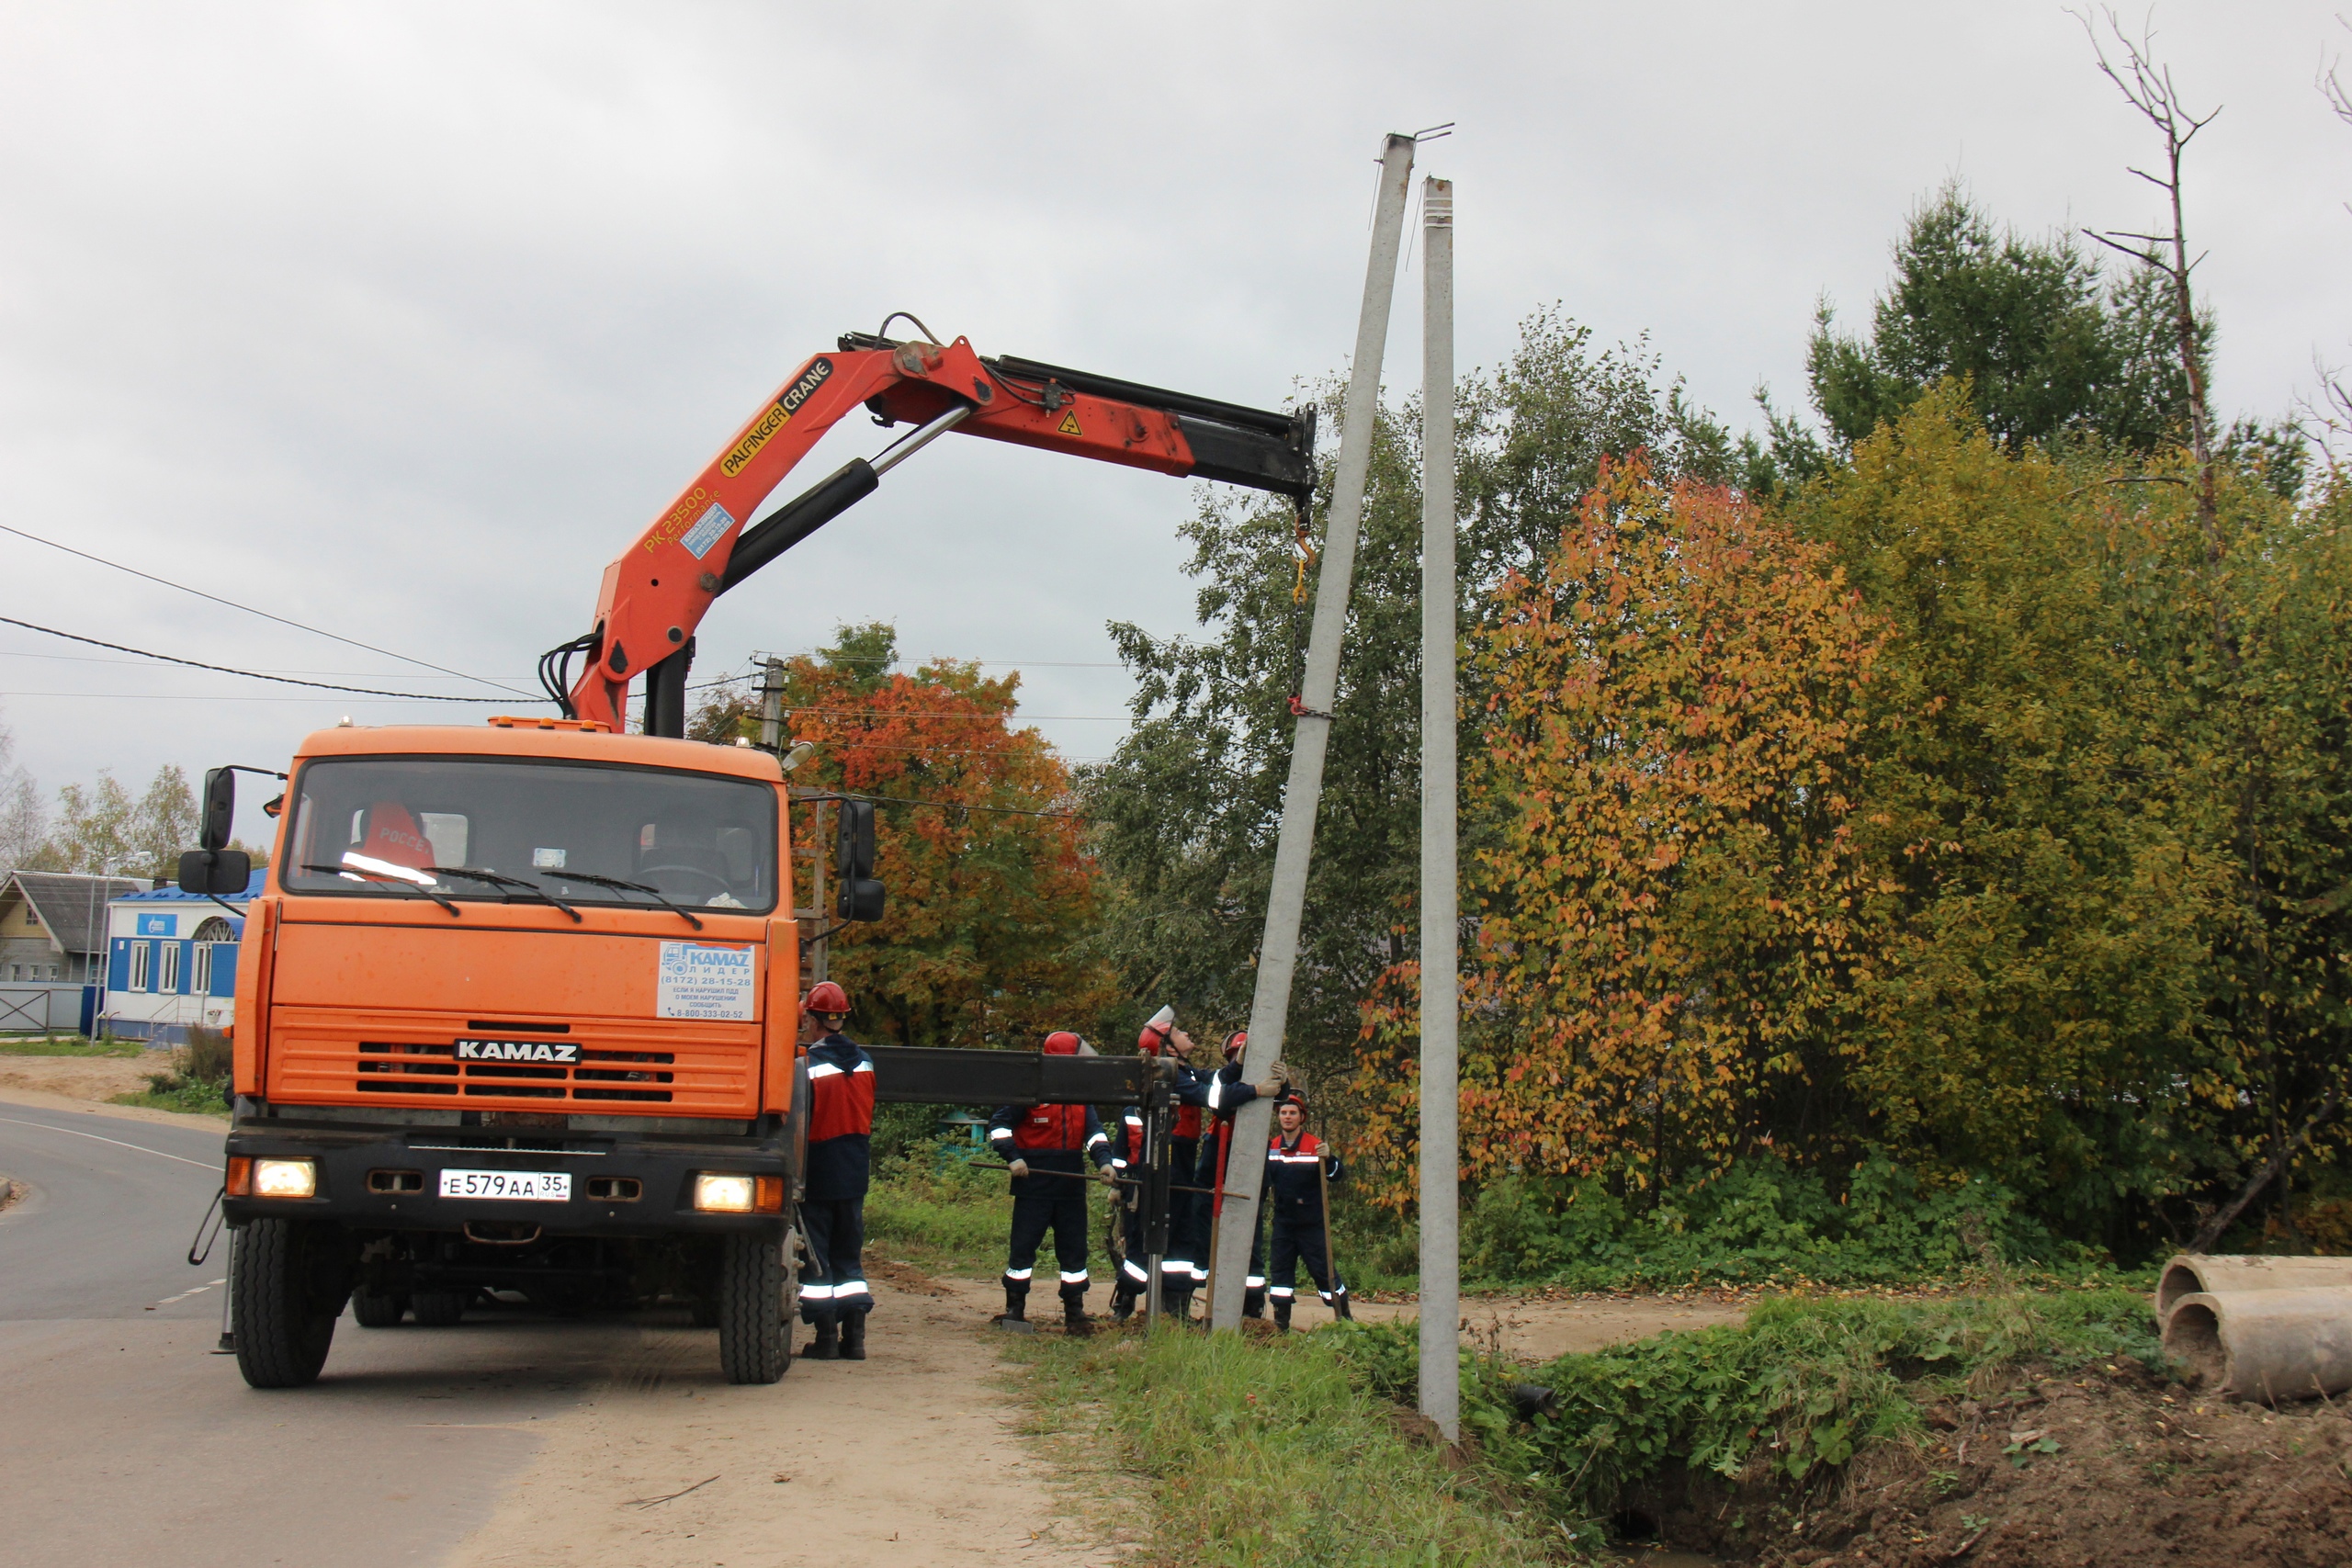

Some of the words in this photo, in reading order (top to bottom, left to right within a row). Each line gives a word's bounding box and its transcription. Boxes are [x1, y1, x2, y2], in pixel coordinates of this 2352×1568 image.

[723, 407, 786, 474] PALFINGER
[783, 362, 830, 411] CRANE
[644, 533, 666, 553] PK
[662, 487, 707, 535] 23500
[667, 490, 720, 547] Performance
[690, 952, 749, 966] KAMAZ
[662, 976, 697, 985] (8172)
[702, 977, 751, 987] 28-15-28
[676, 1010, 743, 1019] 8-800-333-02-52
[458, 1042, 577, 1062] KAMAZ
[542, 1176, 562, 1191] 35
